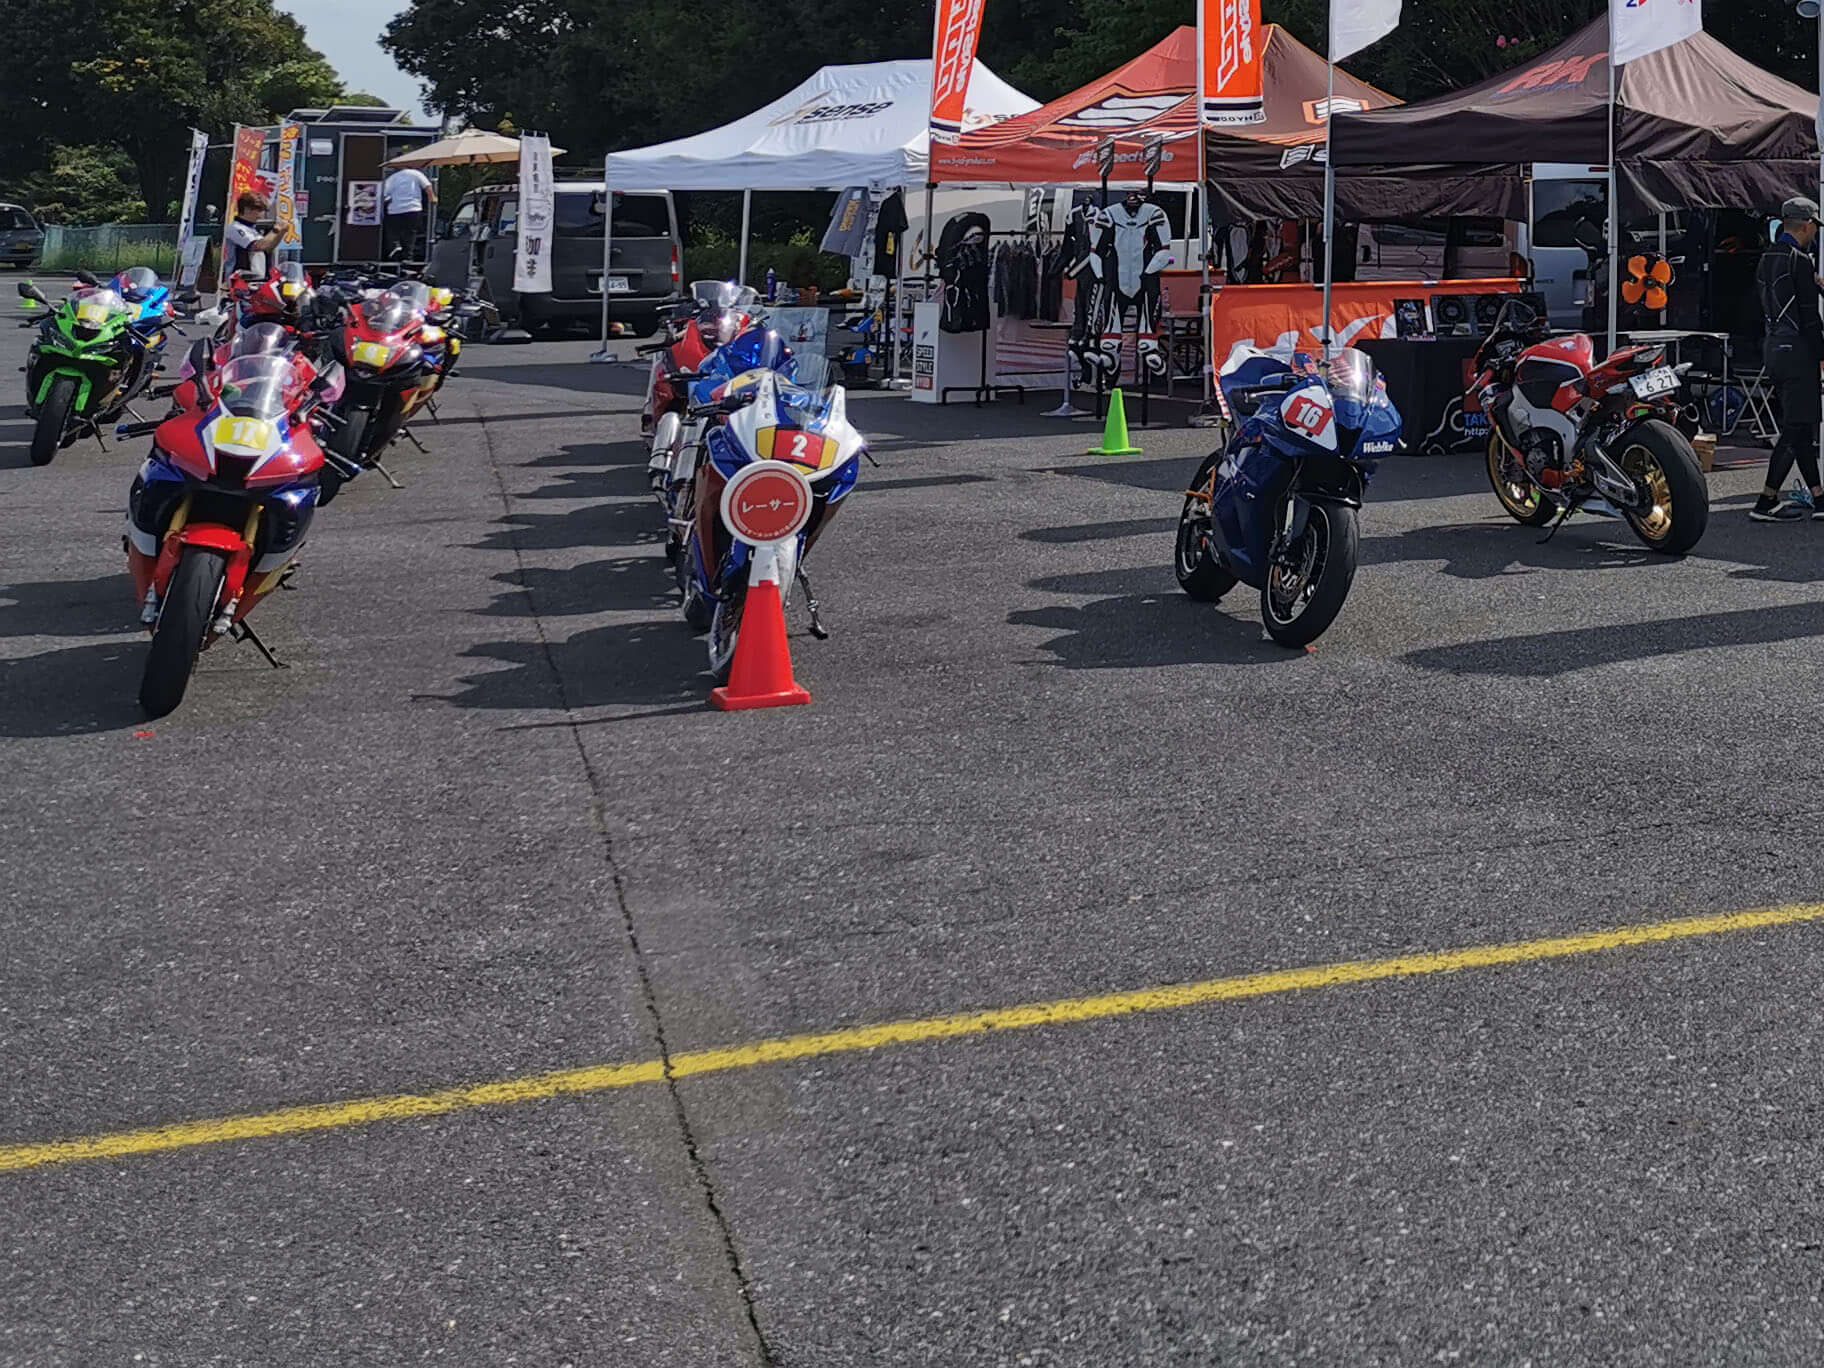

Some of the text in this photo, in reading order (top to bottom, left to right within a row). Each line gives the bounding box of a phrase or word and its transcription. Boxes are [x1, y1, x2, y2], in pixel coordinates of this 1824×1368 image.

[1296, 402, 1323, 428] 16
[1464, 414, 1487, 427] TAK
[1464, 427, 1489, 437] http:
[790, 434, 808, 458] 2
[743, 498, 795, 514] レーサー
